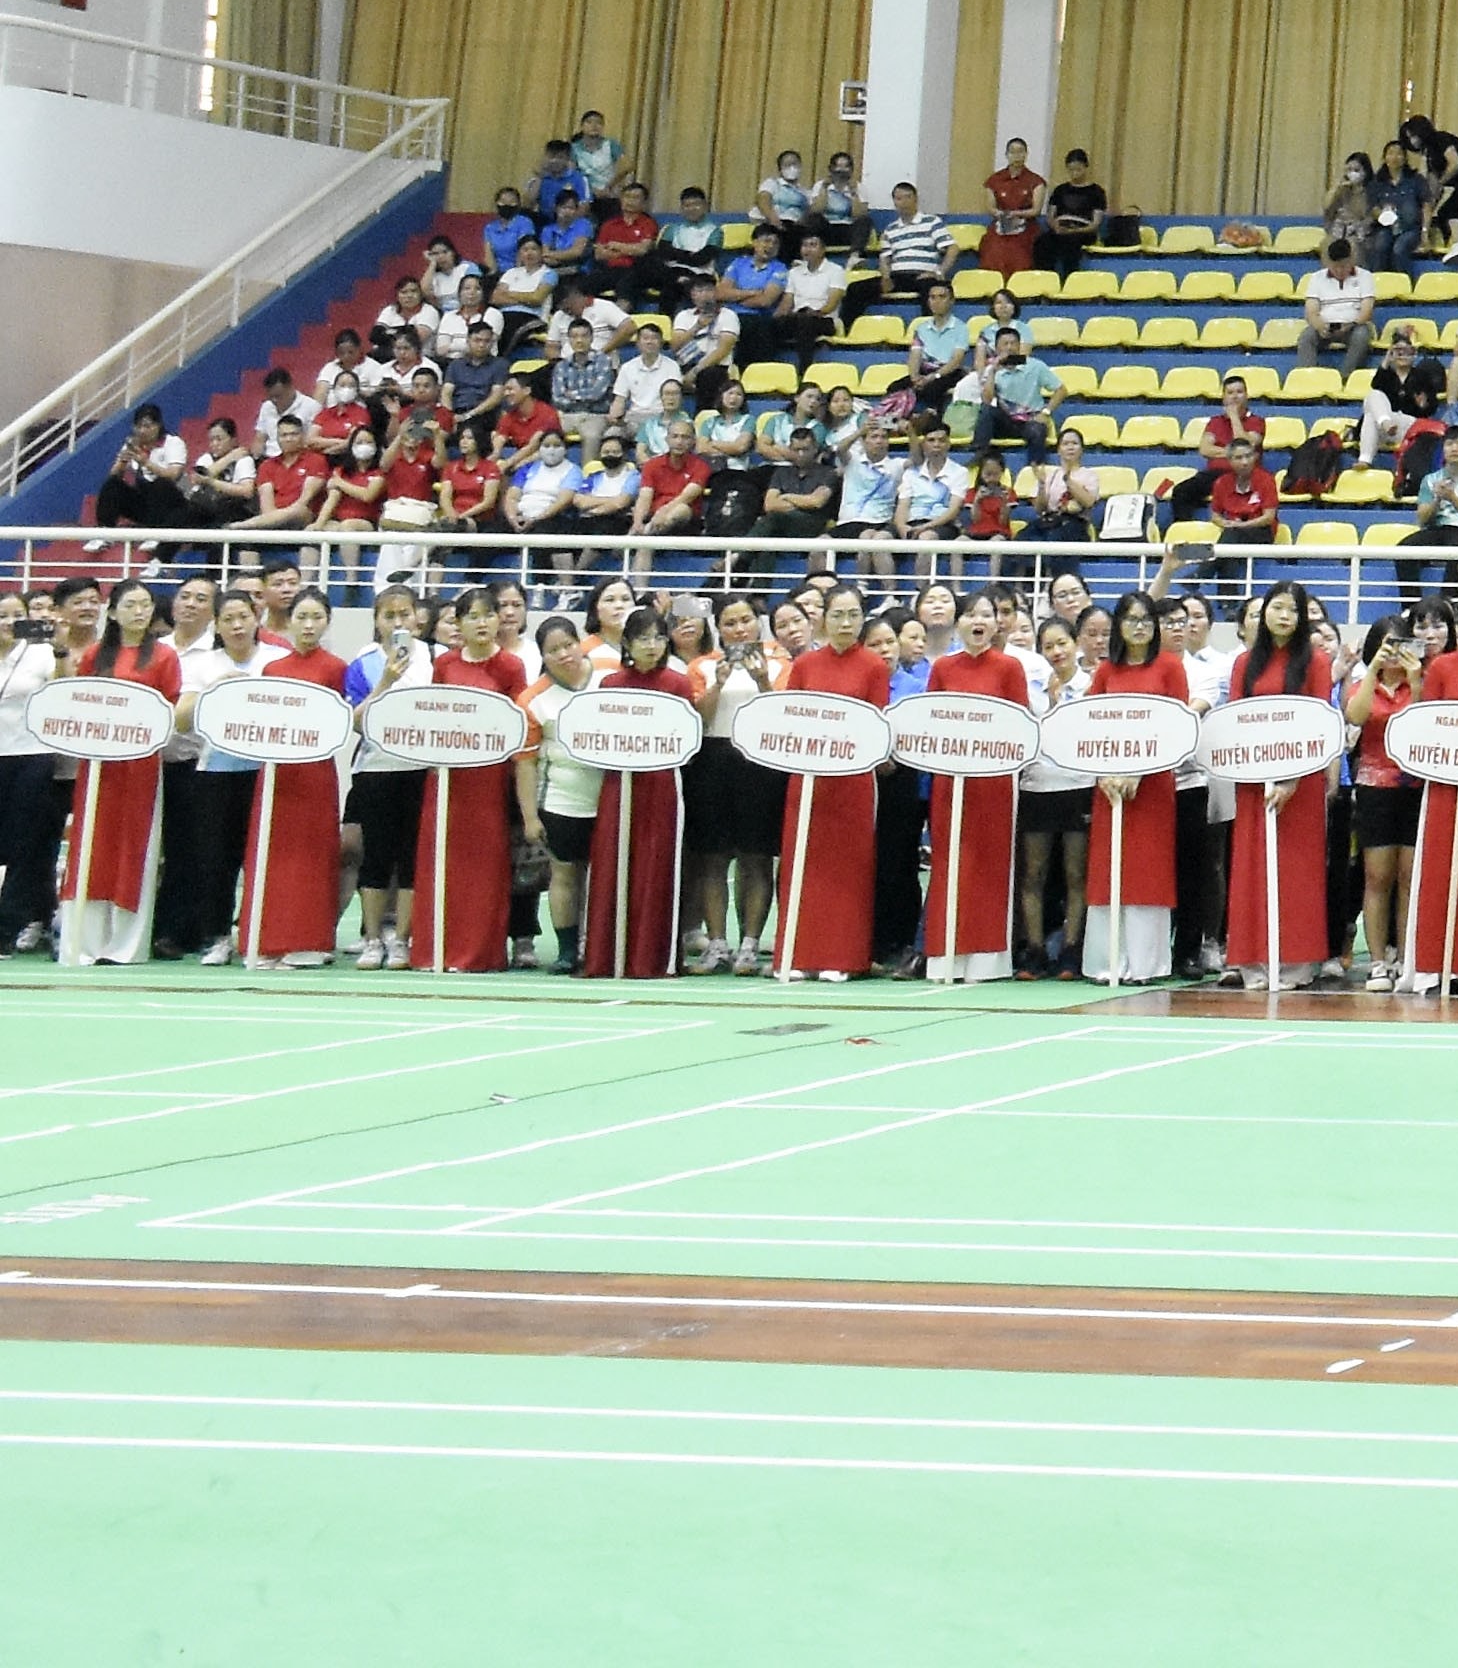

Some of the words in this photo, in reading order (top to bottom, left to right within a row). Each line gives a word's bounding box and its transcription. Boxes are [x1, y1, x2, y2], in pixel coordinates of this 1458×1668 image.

[43, 716, 82, 741] HUYỆN
[85, 718, 109, 741] PHÚ
[113, 723, 152, 745] XUYÊN
[224, 720, 265, 747] HUYỆN
[268, 723, 287, 744] MÊ
[291, 728, 320, 747] LINH
[384, 725, 425, 750] HUYỆN
[486, 726, 506, 752] TÍN
[573, 729, 610, 755] HUYỆN
[613, 733, 651, 758] THẠCH
[654, 728, 682, 754] THẤT
[760, 732, 802, 758] HUYỆN
[806, 734, 826, 757] MỸ
[830, 734, 856, 760] ĐỨC
[896, 732, 937, 758] HUYỆN
[942, 737, 968, 756] ĐAN
[972, 740, 1024, 765] PHƯỢNG
[1077, 736, 1119, 762] HUYỆN
[1124, 740, 1140, 758] BA
[1146, 734, 1158, 757] VÌ
[1212, 743, 1250, 769] HUYỆN
[1254, 742, 1302, 763] CHƯƠNG
[1307, 734, 1324, 758] MỸ
[1409, 742, 1449, 769] HUYỆN
